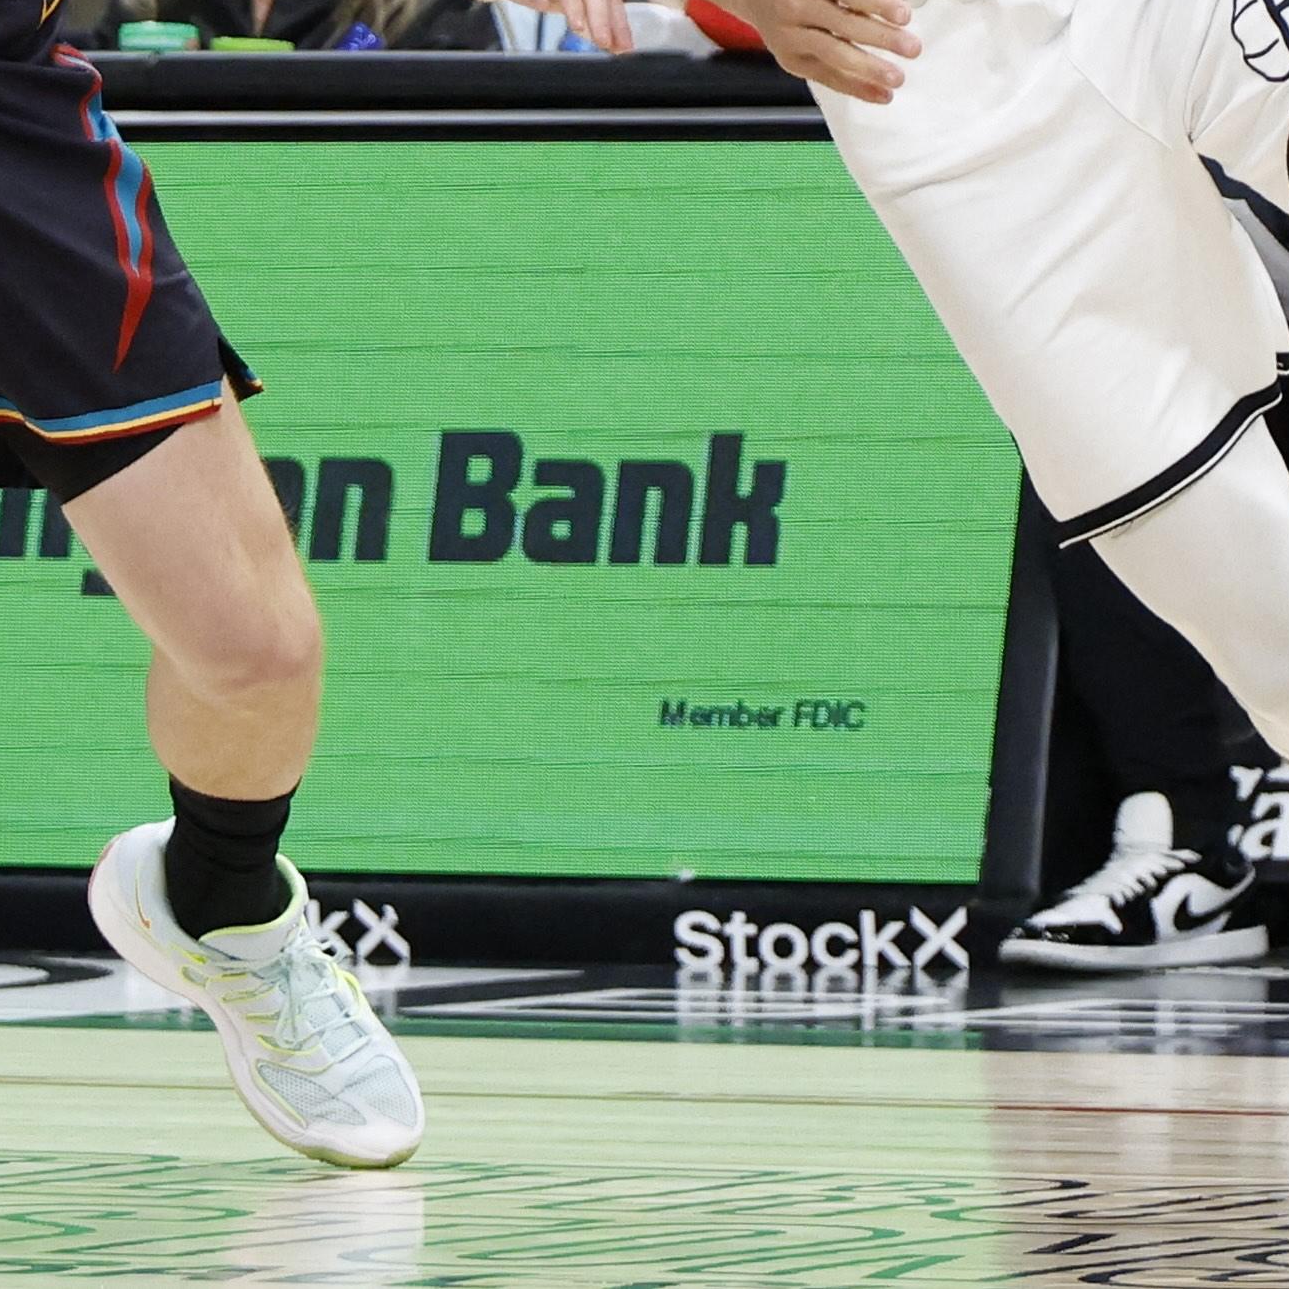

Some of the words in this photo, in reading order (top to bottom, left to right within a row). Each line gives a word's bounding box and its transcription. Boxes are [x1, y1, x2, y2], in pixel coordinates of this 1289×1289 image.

[428, 431, 789, 567] Bank
[661, 697, 786, 729] Member
[791, 698, 866, 732] FDIC
[673, 906, 970, 970] StockX
